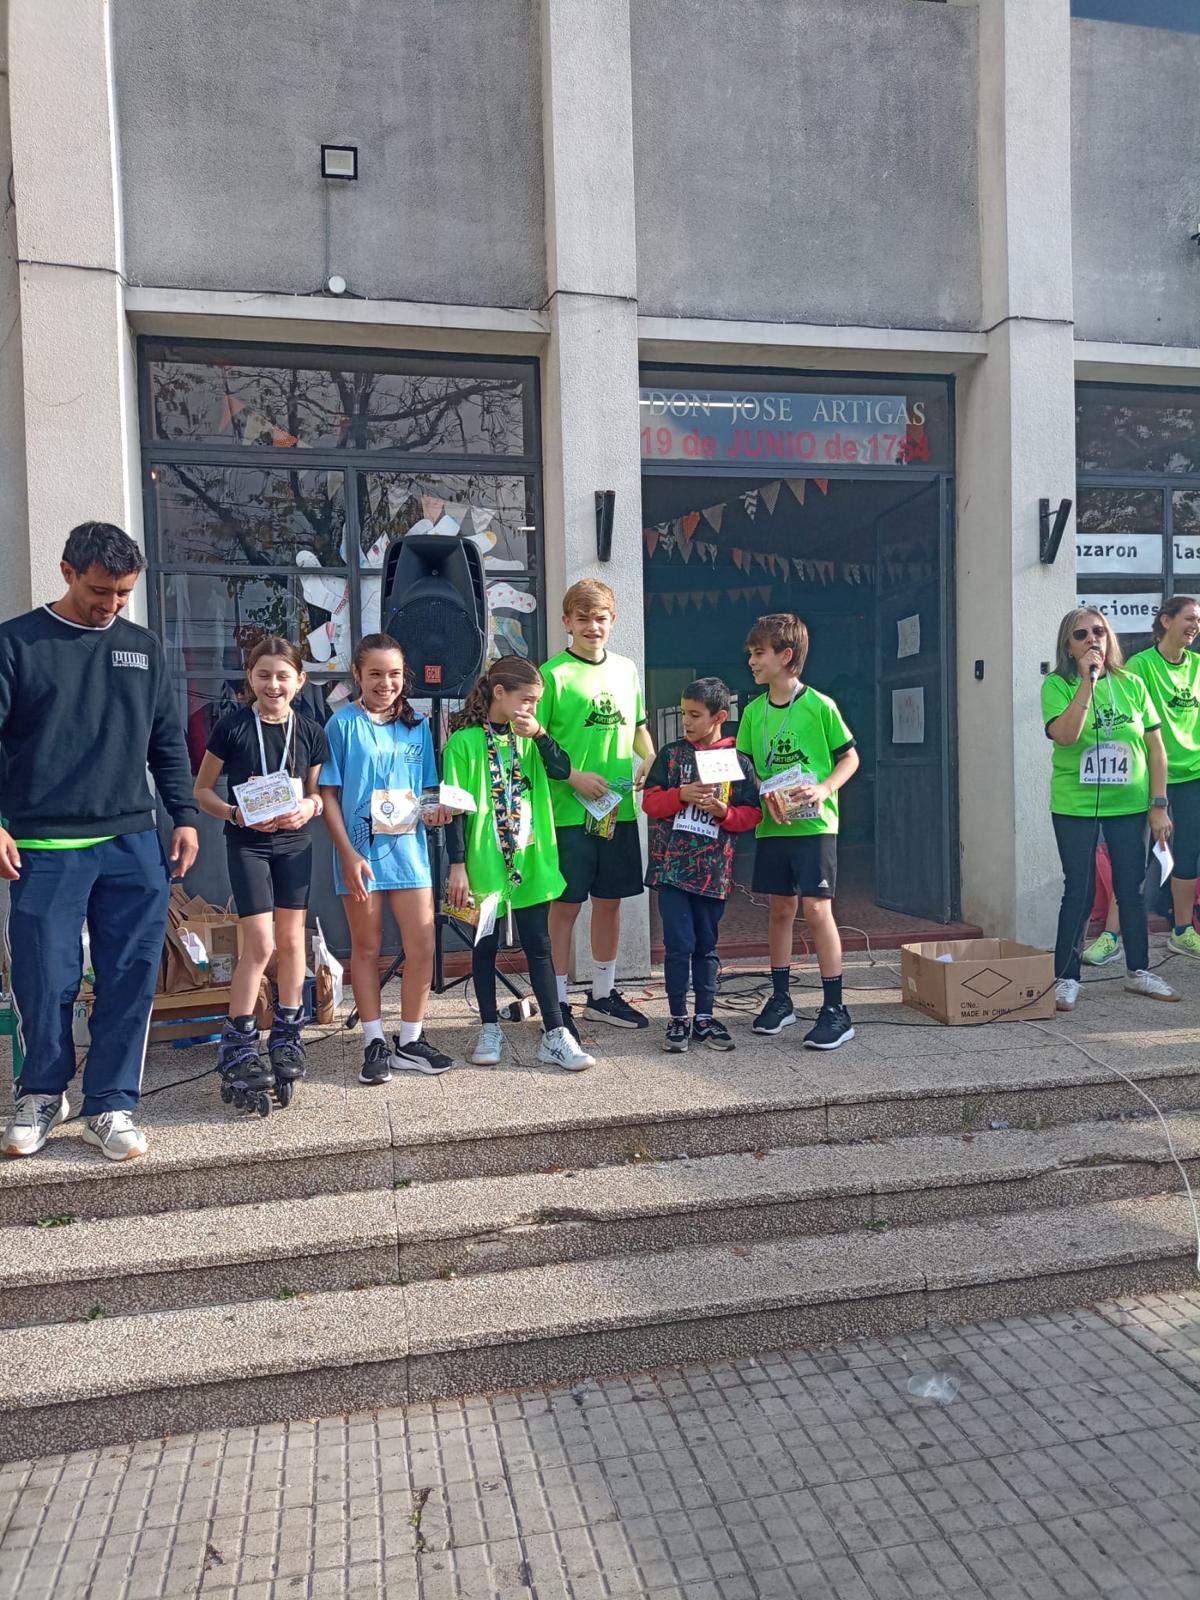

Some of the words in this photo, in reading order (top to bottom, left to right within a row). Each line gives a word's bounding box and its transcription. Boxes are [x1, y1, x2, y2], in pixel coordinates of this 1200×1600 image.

[647, 391, 712, 417] DON
[729, 395, 793, 424] JOSE
[811, 399, 926, 426] ARTIGAS
[640, 427, 672, 455] 19
[682, 428, 716, 457] de
[726, 430, 817, 460] JUNIO
[824, 433, 858, 461] de
[112, 651, 149, 667] PUMA
[961, 1010, 980, 1018] MADE
